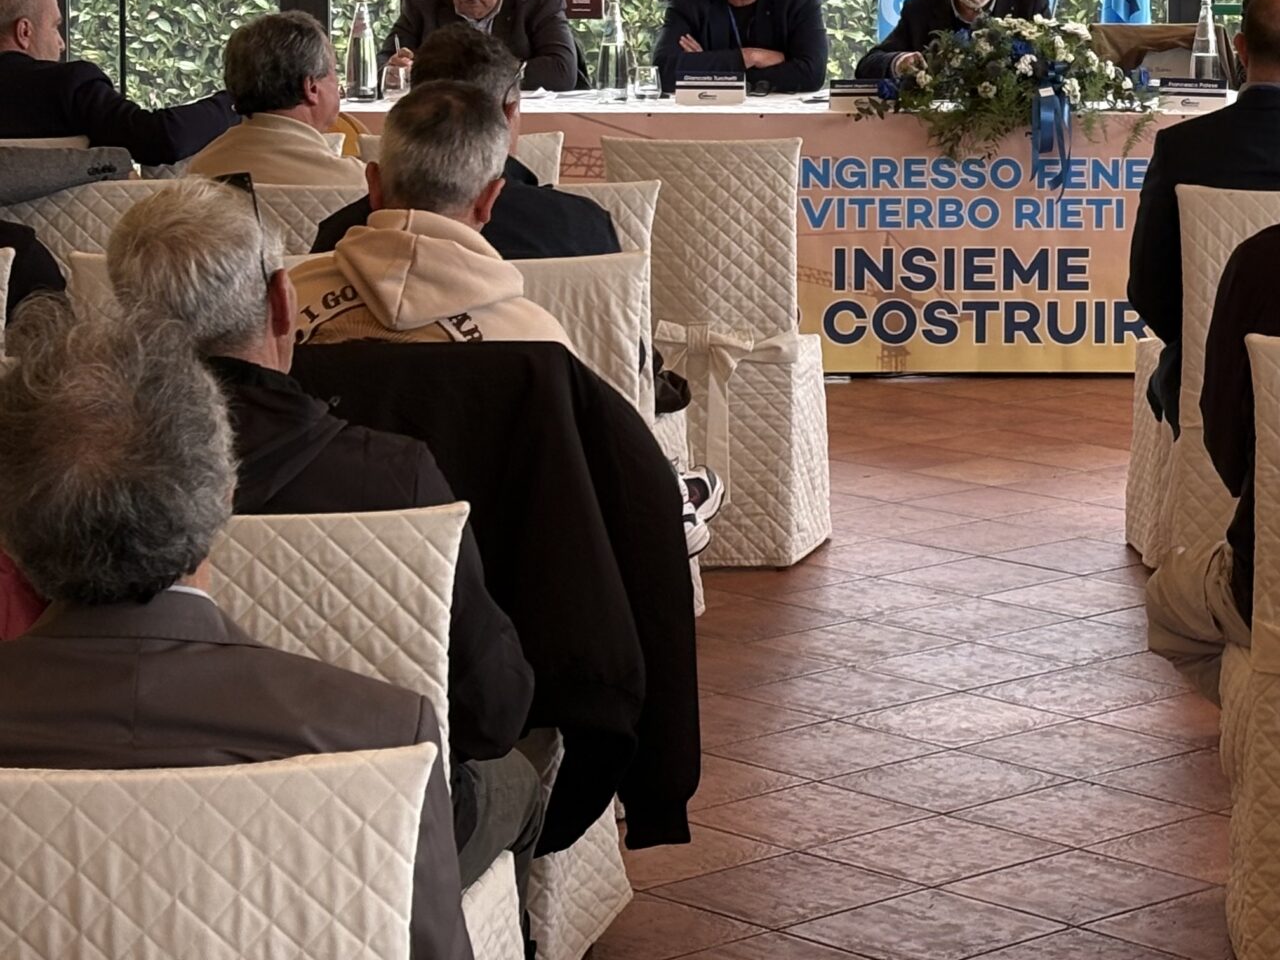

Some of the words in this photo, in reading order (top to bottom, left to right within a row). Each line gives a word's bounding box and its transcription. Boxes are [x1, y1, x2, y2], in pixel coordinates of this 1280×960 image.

[801, 157, 1022, 190] NGRESSO
[1036, 157, 1150, 190] FENE
[801, 197, 1000, 230] VITERBO
[1014, 197, 1125, 230] RIETI
[833, 247, 1091, 293] INSIEME
[321, 285, 359, 310] GO
[823, 299, 1150, 346] COSTRUIR
